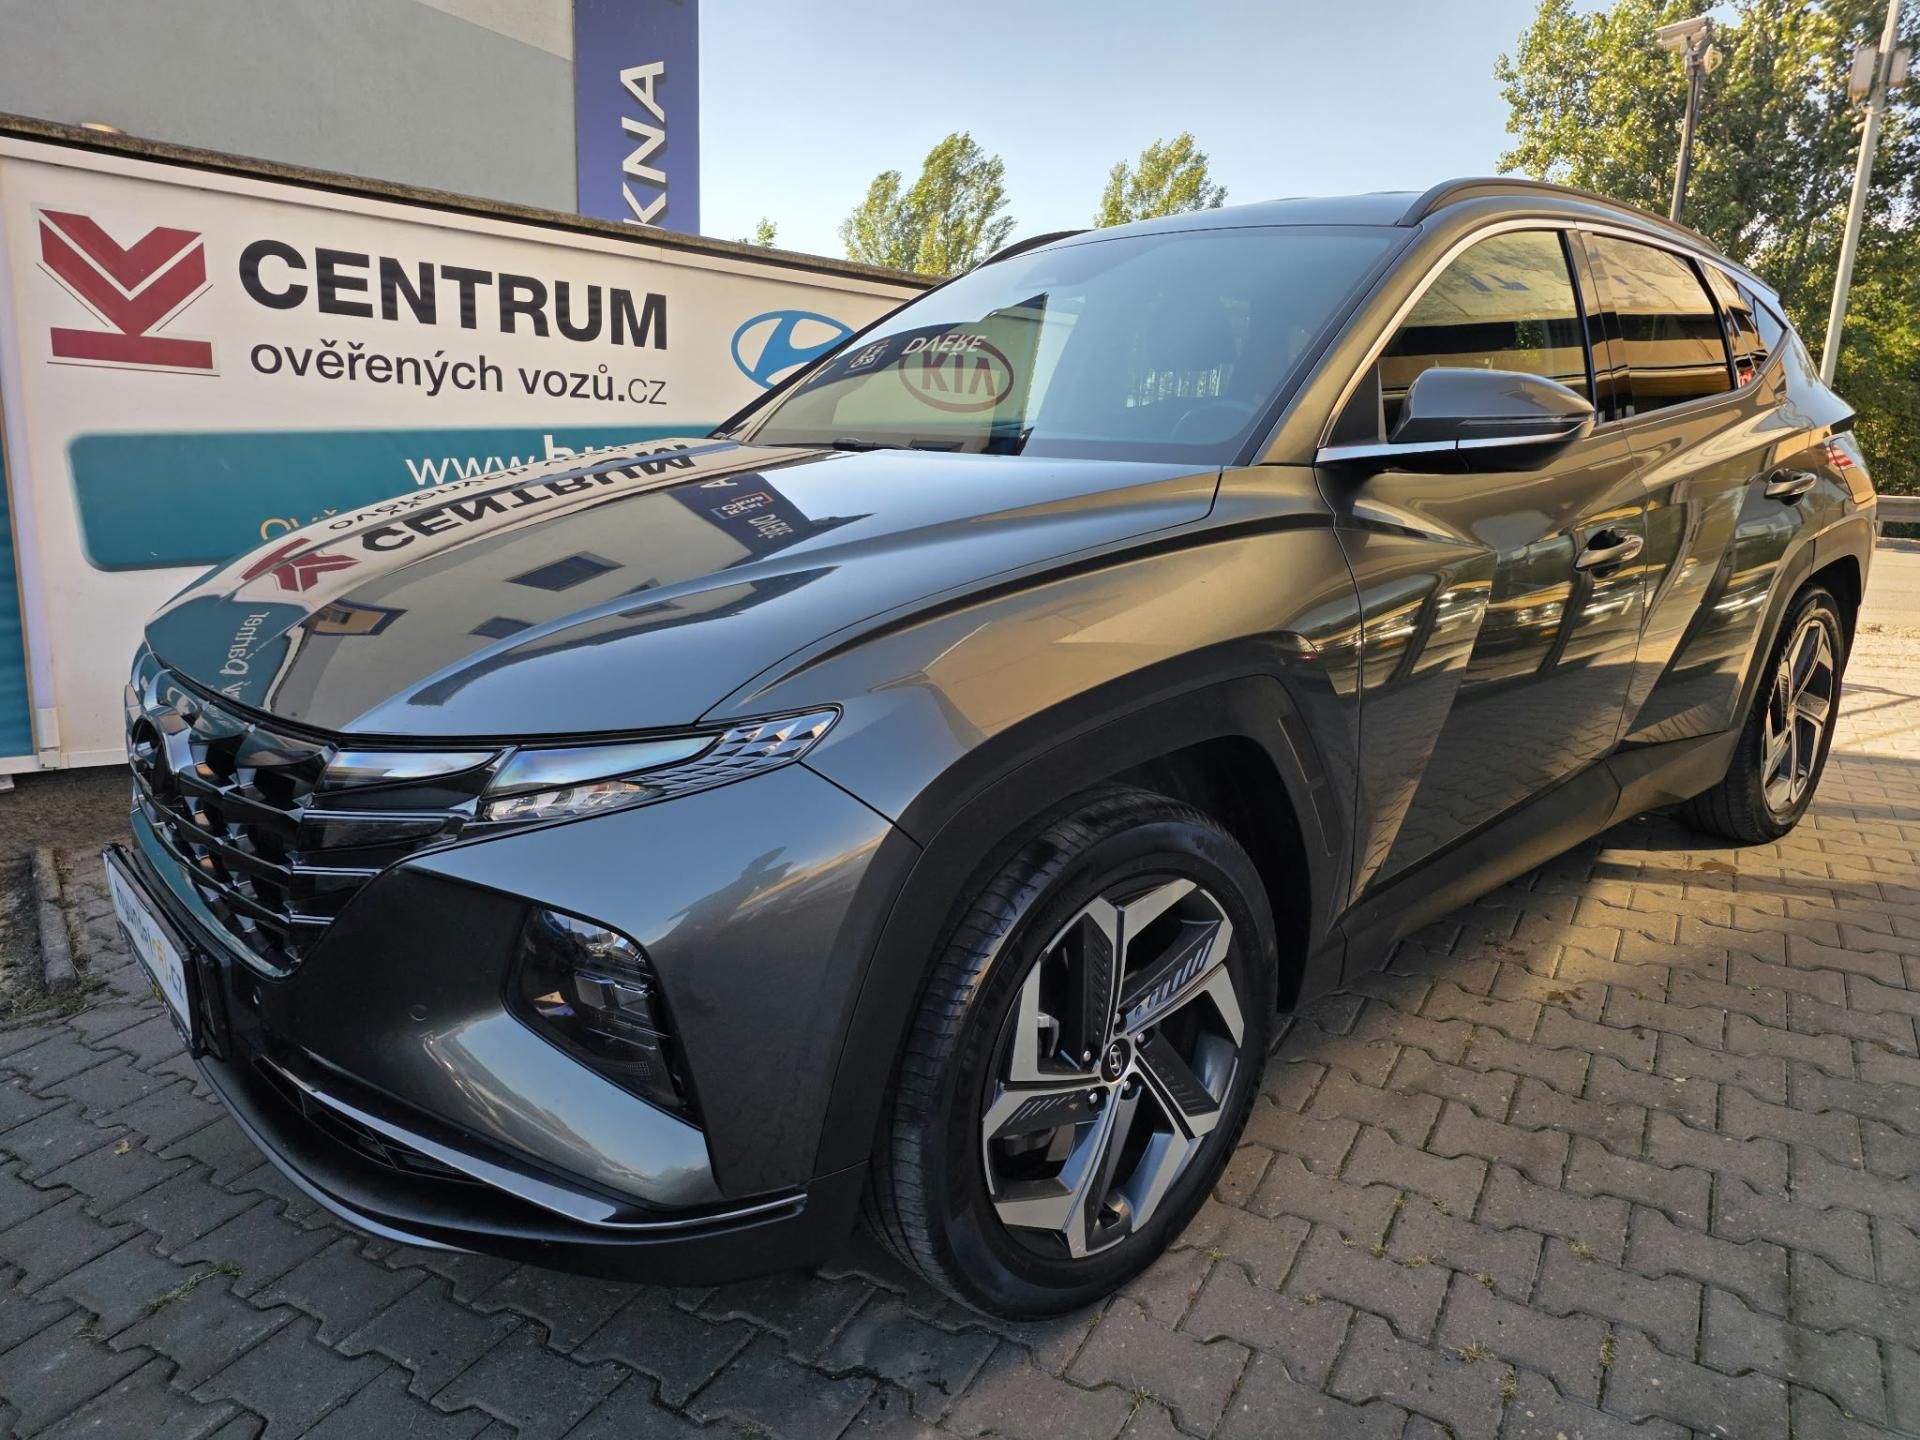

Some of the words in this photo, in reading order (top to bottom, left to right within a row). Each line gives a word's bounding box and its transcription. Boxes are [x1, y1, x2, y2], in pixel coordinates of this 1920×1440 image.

[239, 239, 668, 350] CENTRUM
[250, 338, 503, 397] ověřených
[518, 364, 668, 405] vozů.cz
[921, 350, 996, 396] KIA
